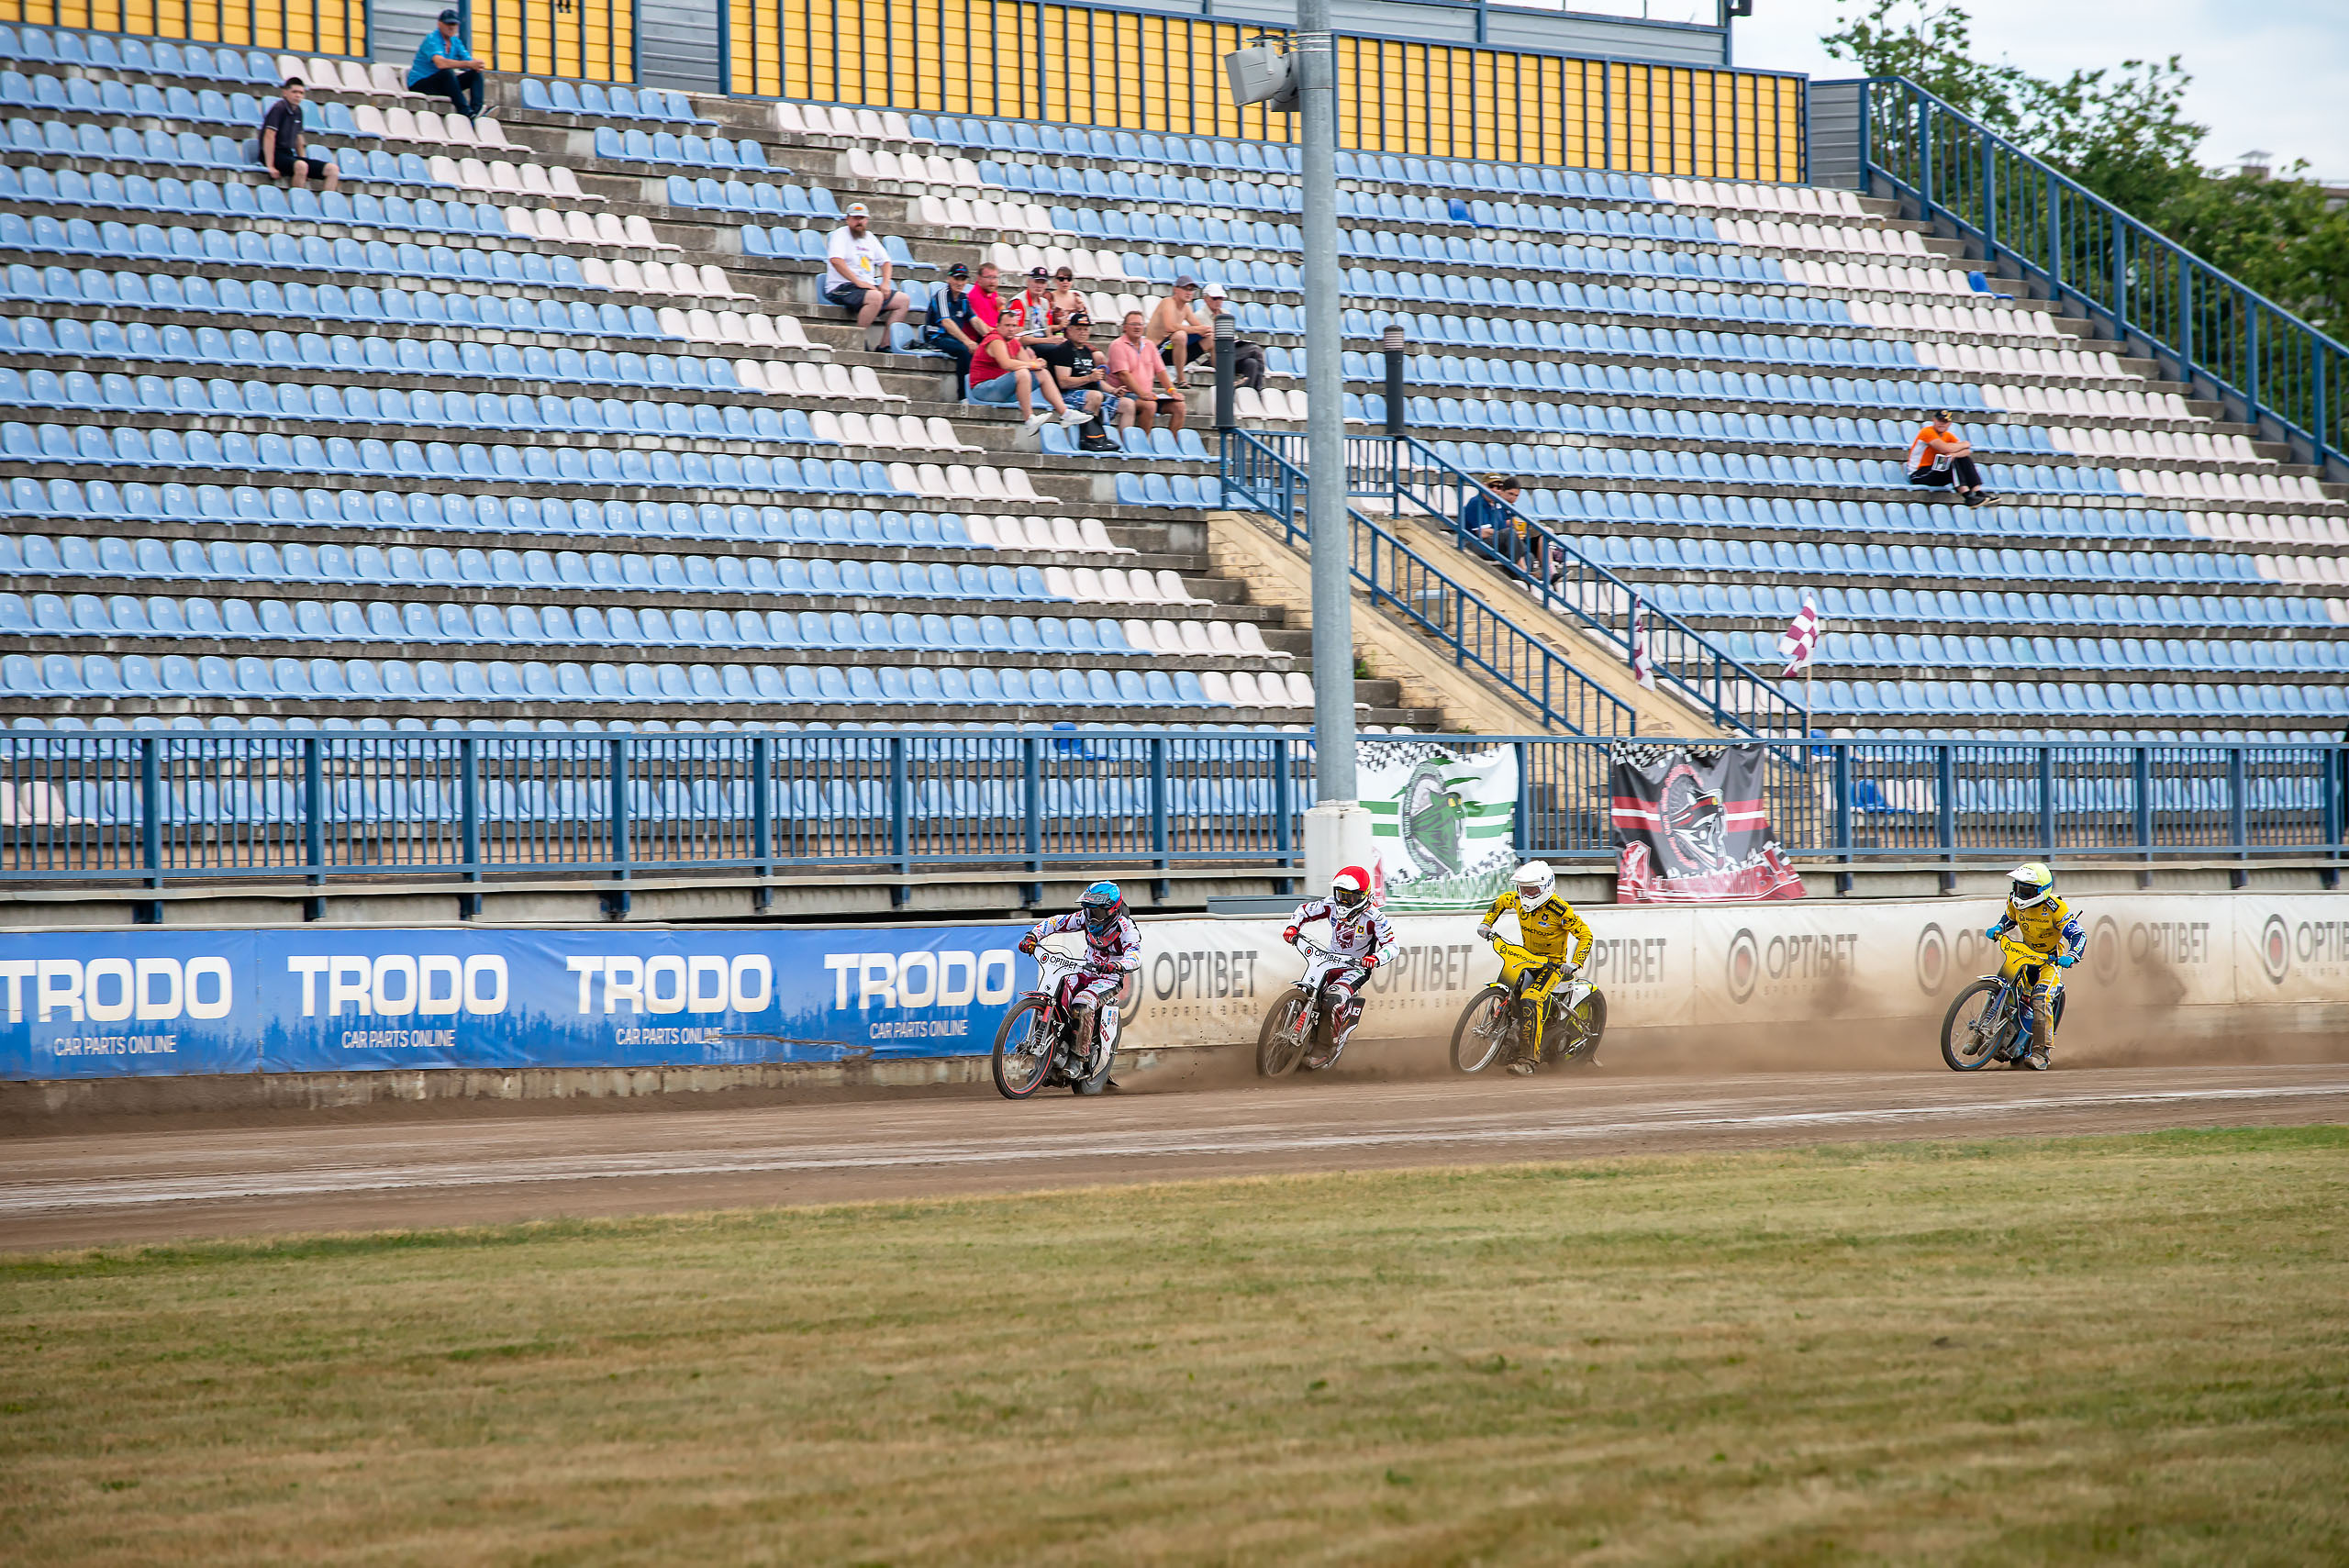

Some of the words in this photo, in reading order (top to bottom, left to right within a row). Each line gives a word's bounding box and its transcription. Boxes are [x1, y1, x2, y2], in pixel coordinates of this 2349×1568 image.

[1050, 956, 1078, 970] OPTIBET
[1315, 950, 1341, 964] OPTIBET
[1507, 951, 1536, 964] spechouse
[1586, 938, 1667, 984] PTIBET
[1767, 934, 1857, 979] OPTIBET
[2128, 922, 2210, 963] OPTIBET
[0, 956, 233, 1024] TRODO
[287, 953, 509, 1017] TRODO
[565, 953, 773, 1014] TRODO
[823, 949, 1017, 1011] TRODO
[1153, 951, 1257, 1001] OPTIBET
[54, 1038, 83, 1056] CAR
[83, 1036, 127, 1055] PARTS
[128, 1035, 176, 1053] ONLINE
[341, 1030, 368, 1049] CAR
[369, 1029, 409, 1048] PARTS
[410, 1029, 456, 1047] ONLINE
[616, 1028, 641, 1045] CAR
[642, 1028, 680, 1045] PARTS
[681, 1027, 723, 1044] ONLINE
[870, 1022, 893, 1040] CAR
[894, 1020, 928, 1039] PARTS
[929, 1019, 968, 1037] ONLINE
